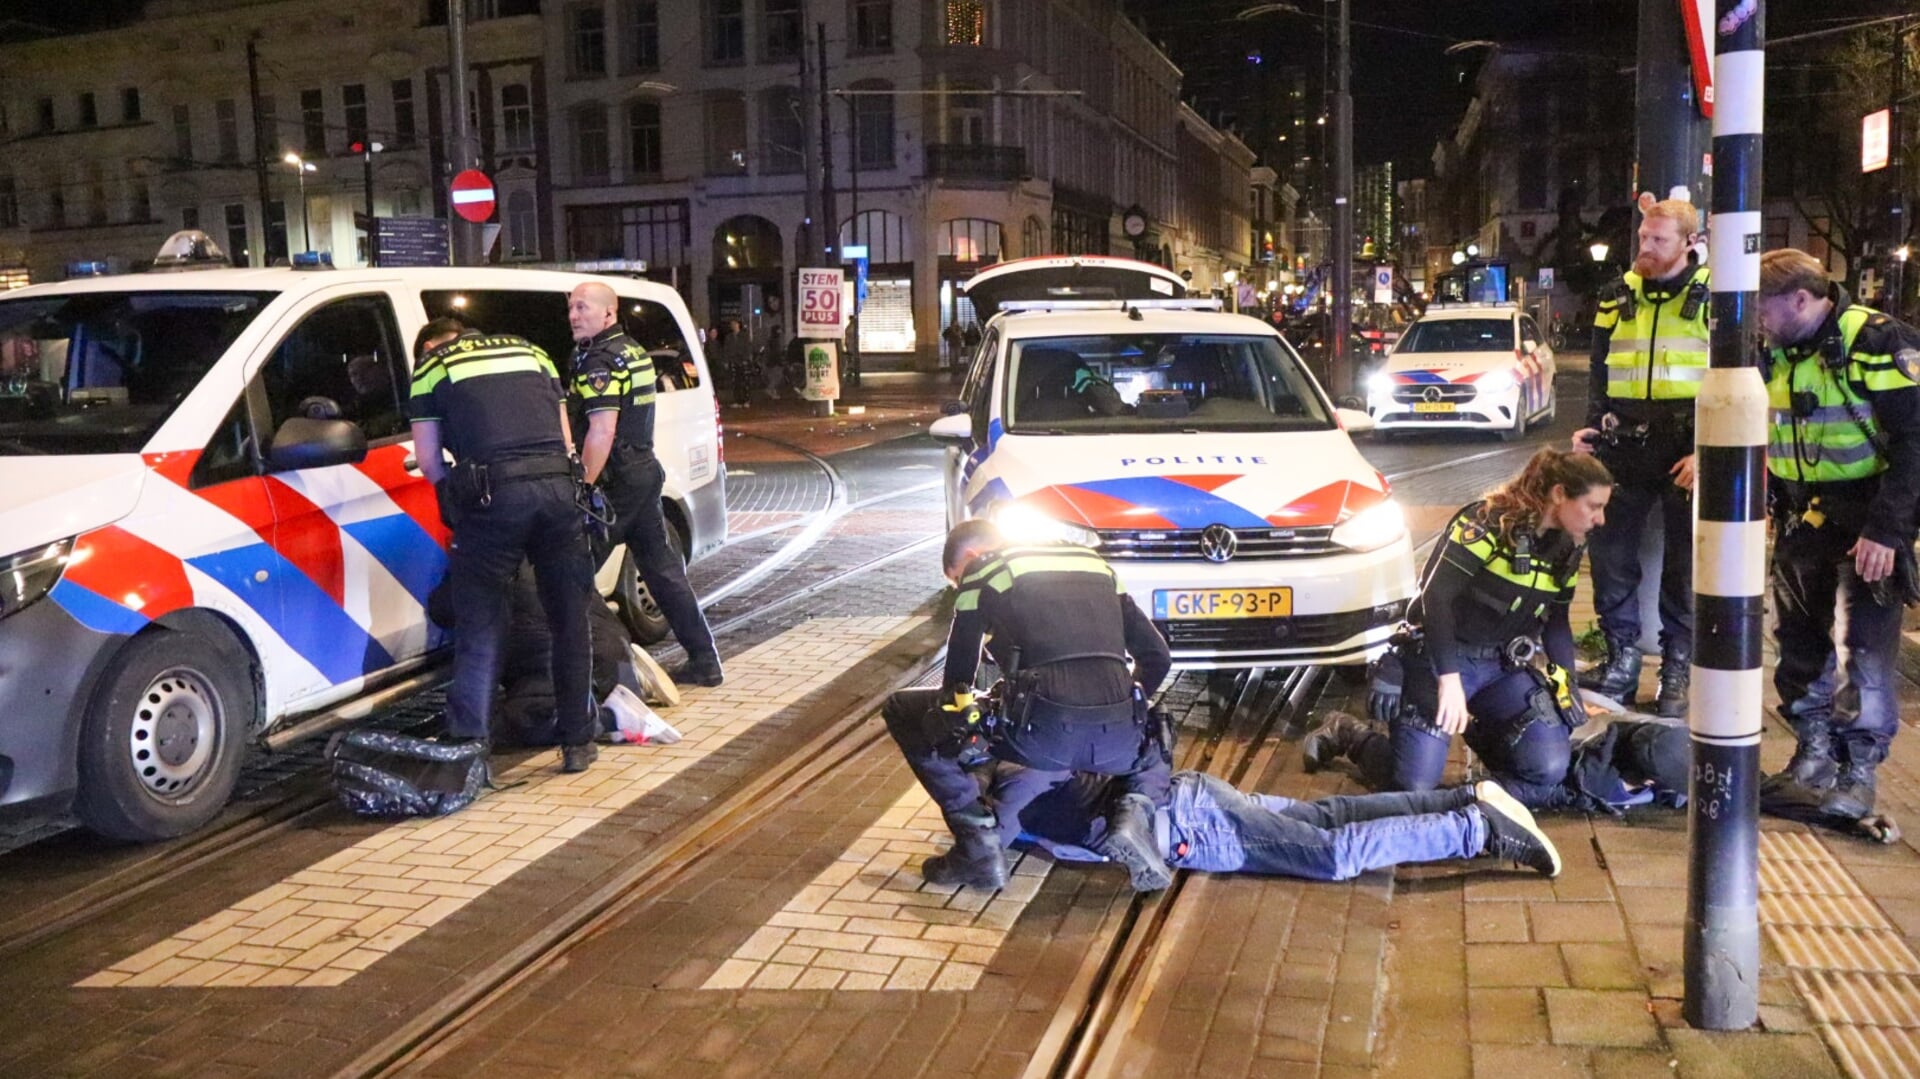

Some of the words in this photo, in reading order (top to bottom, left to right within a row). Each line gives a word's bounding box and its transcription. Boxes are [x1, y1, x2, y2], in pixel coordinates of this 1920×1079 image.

[802, 273, 838, 285] STEM
[805, 290, 835, 310] 50
[805, 312, 834, 321] PLUS
[1120, 456, 1268, 467] POLITIE
[1175, 592, 1282, 615] GKF-93-P
